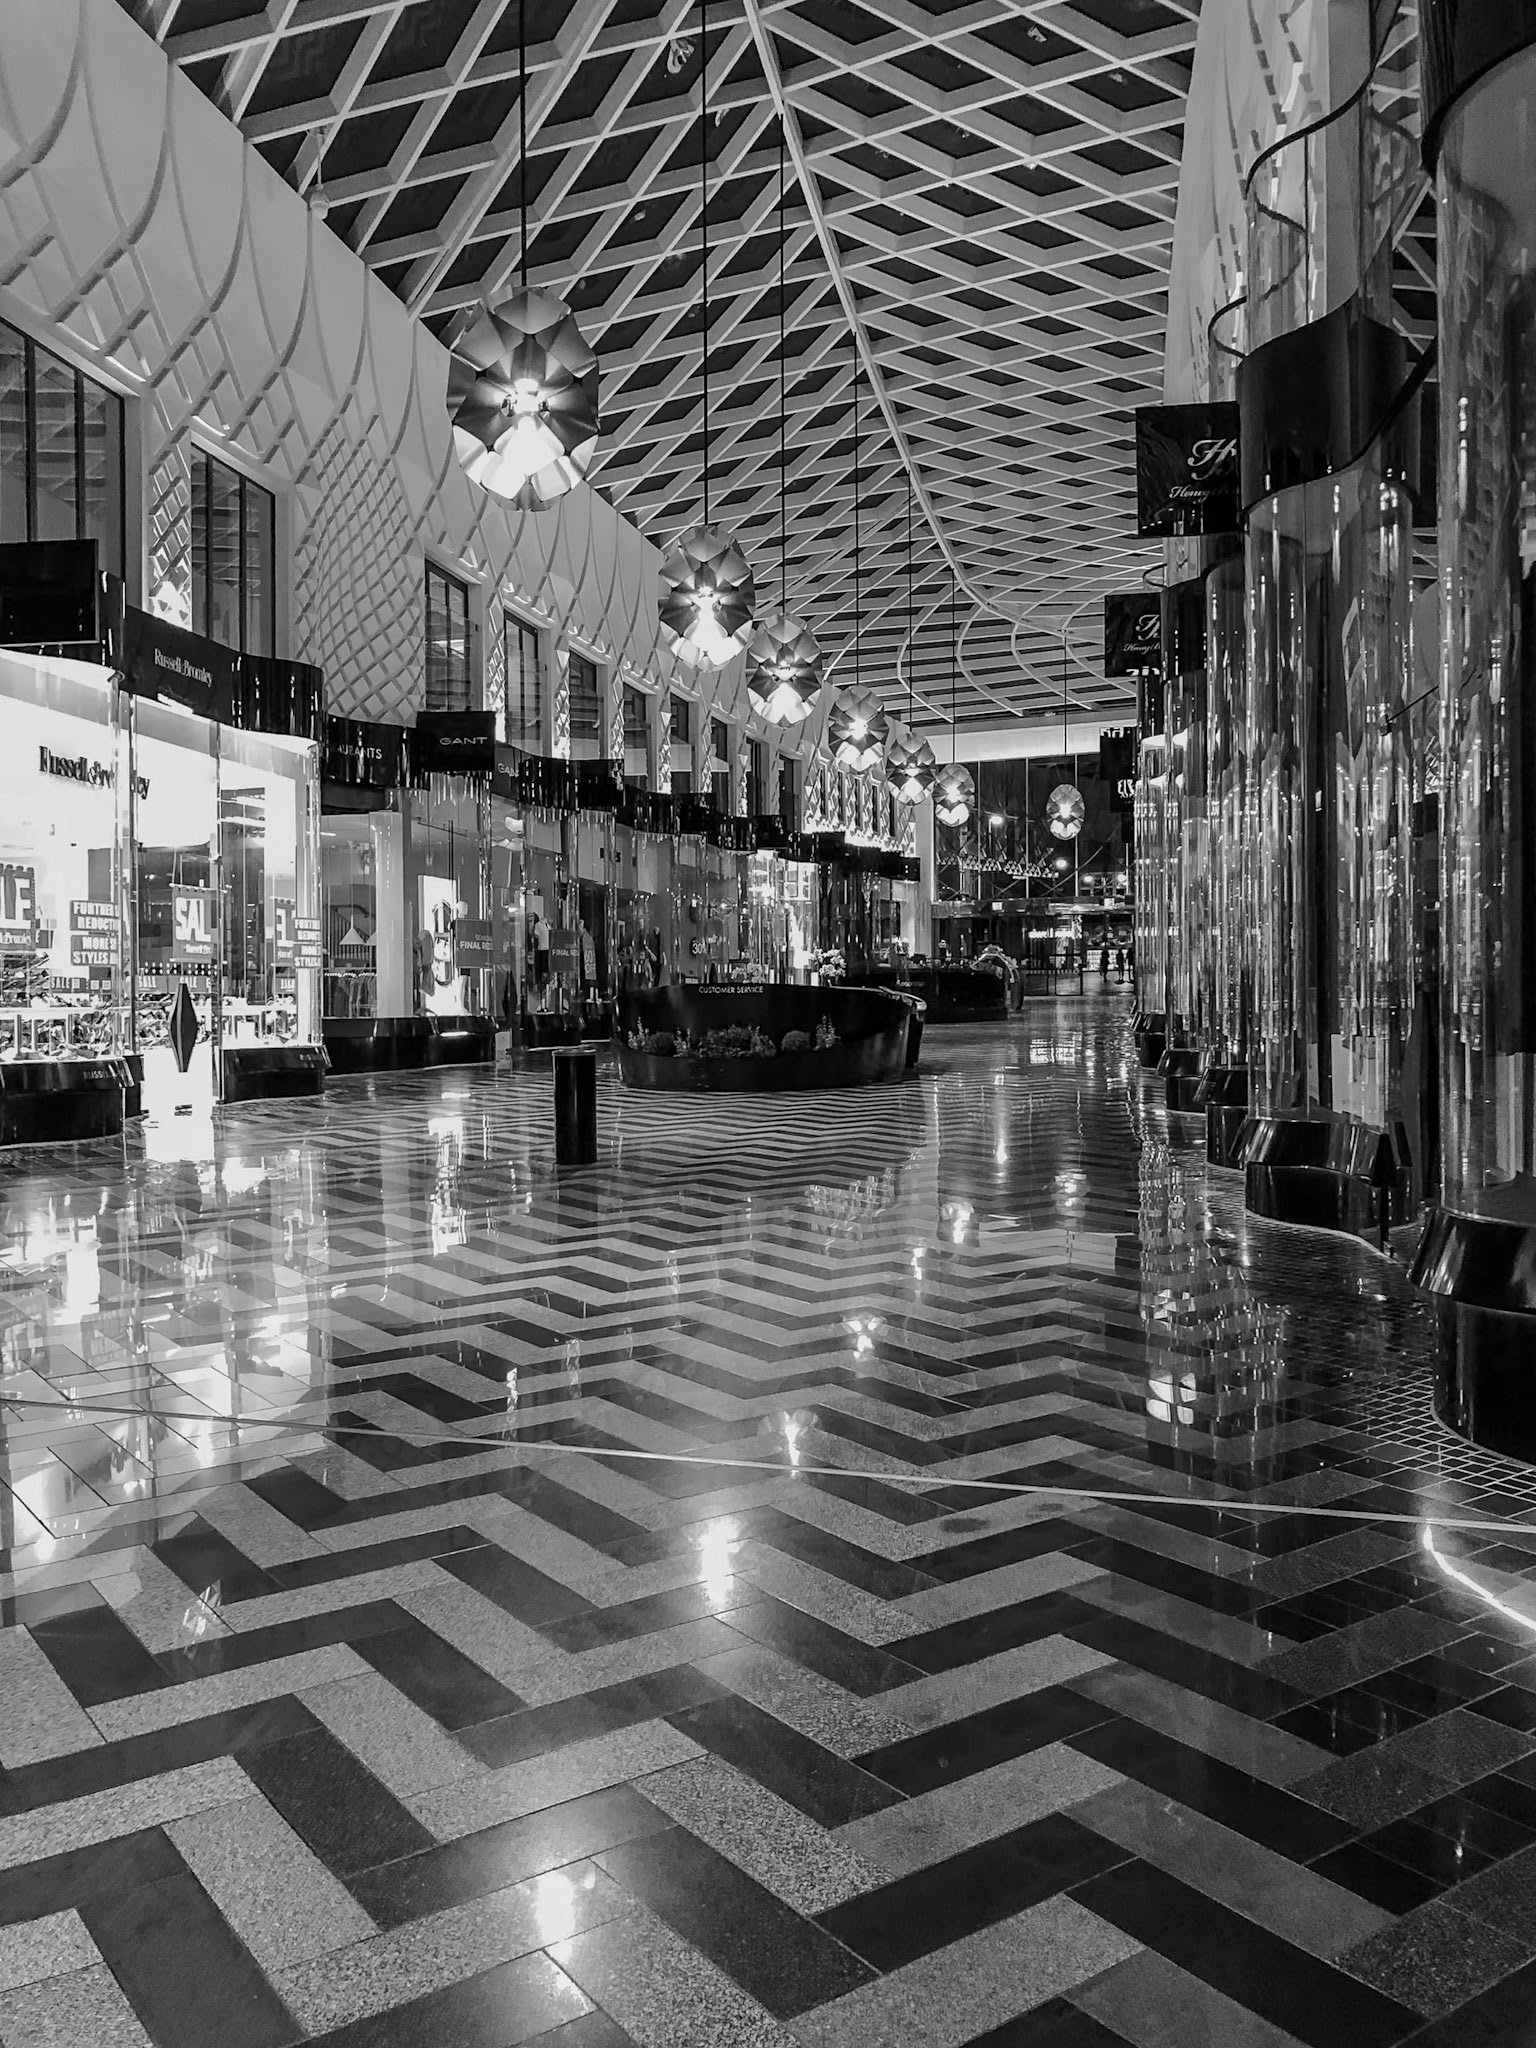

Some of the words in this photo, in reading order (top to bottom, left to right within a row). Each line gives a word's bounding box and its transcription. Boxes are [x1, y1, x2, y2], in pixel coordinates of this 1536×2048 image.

[440, 736, 488, 746] GANT
[460, 940, 481, 950] FINAL
[72, 951, 109, 965] STYLES
[552, 949, 570, 957] FINAL
[138, 975, 157, 989] SALE
[699, 986, 736, 994] CUSTOMER
[736, 985, 764, 994] SERVICE
